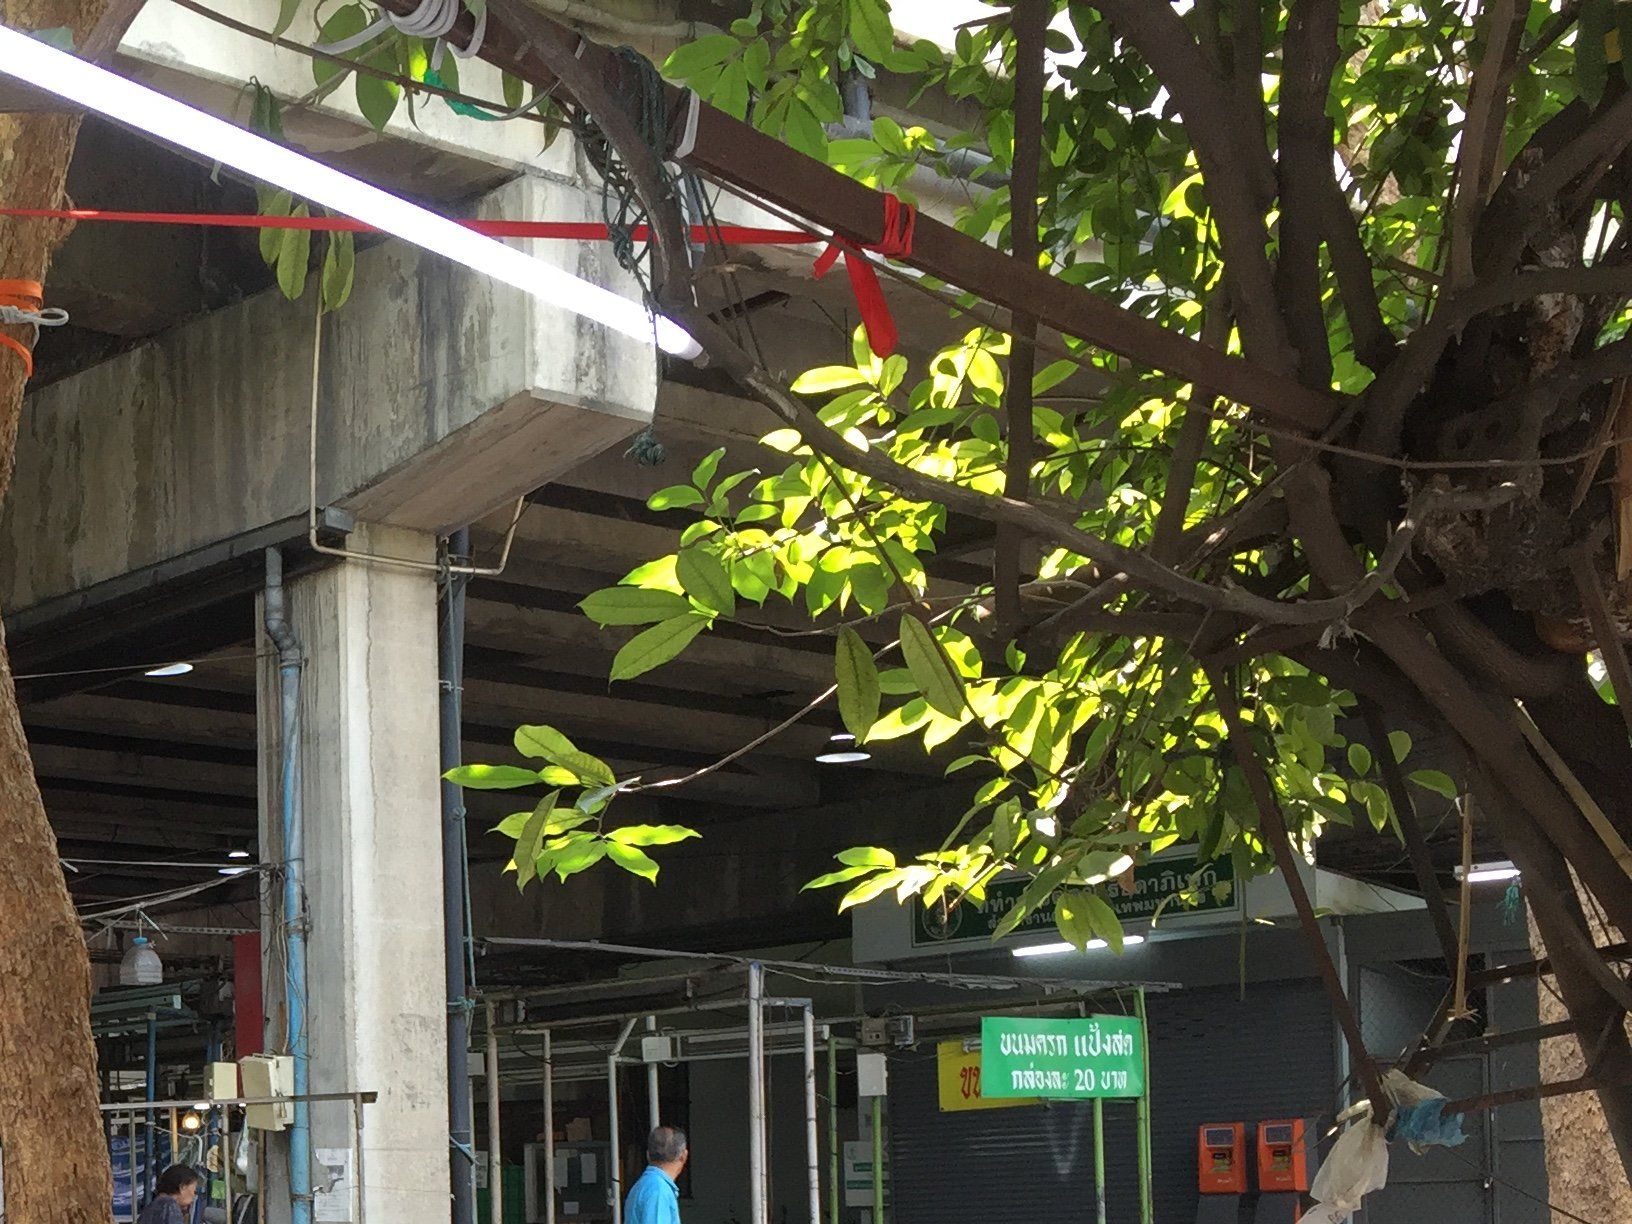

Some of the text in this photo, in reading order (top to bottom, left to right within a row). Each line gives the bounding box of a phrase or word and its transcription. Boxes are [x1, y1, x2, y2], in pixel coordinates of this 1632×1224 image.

[1011, 1061, 1128, 1091] กล่องละ 20 บาท
